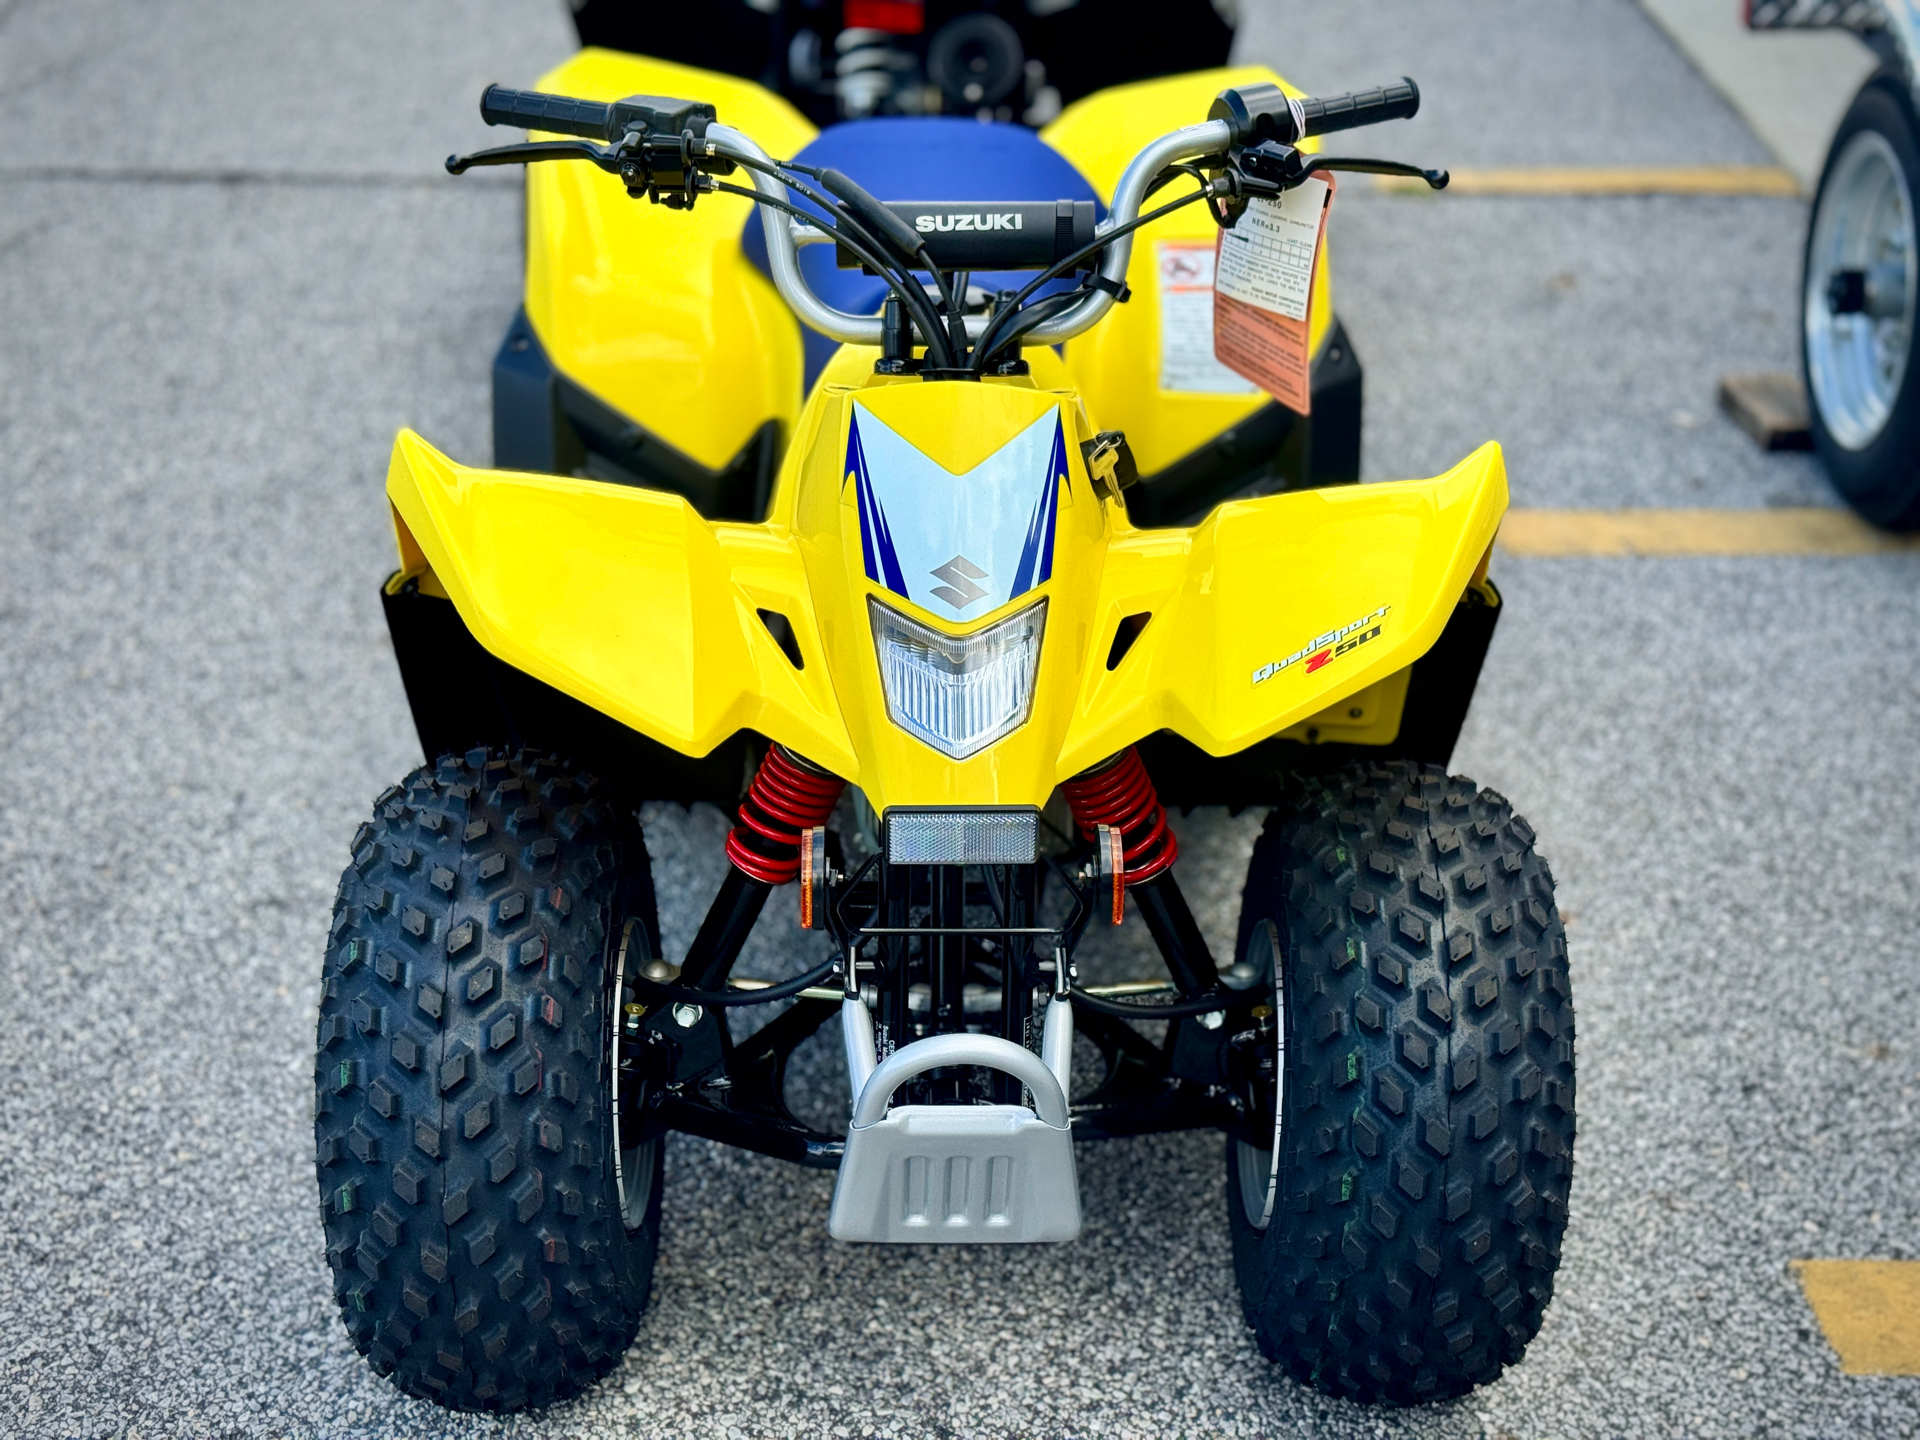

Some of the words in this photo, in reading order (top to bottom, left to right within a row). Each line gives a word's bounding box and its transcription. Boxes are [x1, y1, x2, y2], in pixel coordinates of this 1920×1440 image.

[915, 213, 1022, 233] SUZUKI
[1252, 604, 1392, 684] QuadSport
[1305, 624, 1382, 674] Z50
